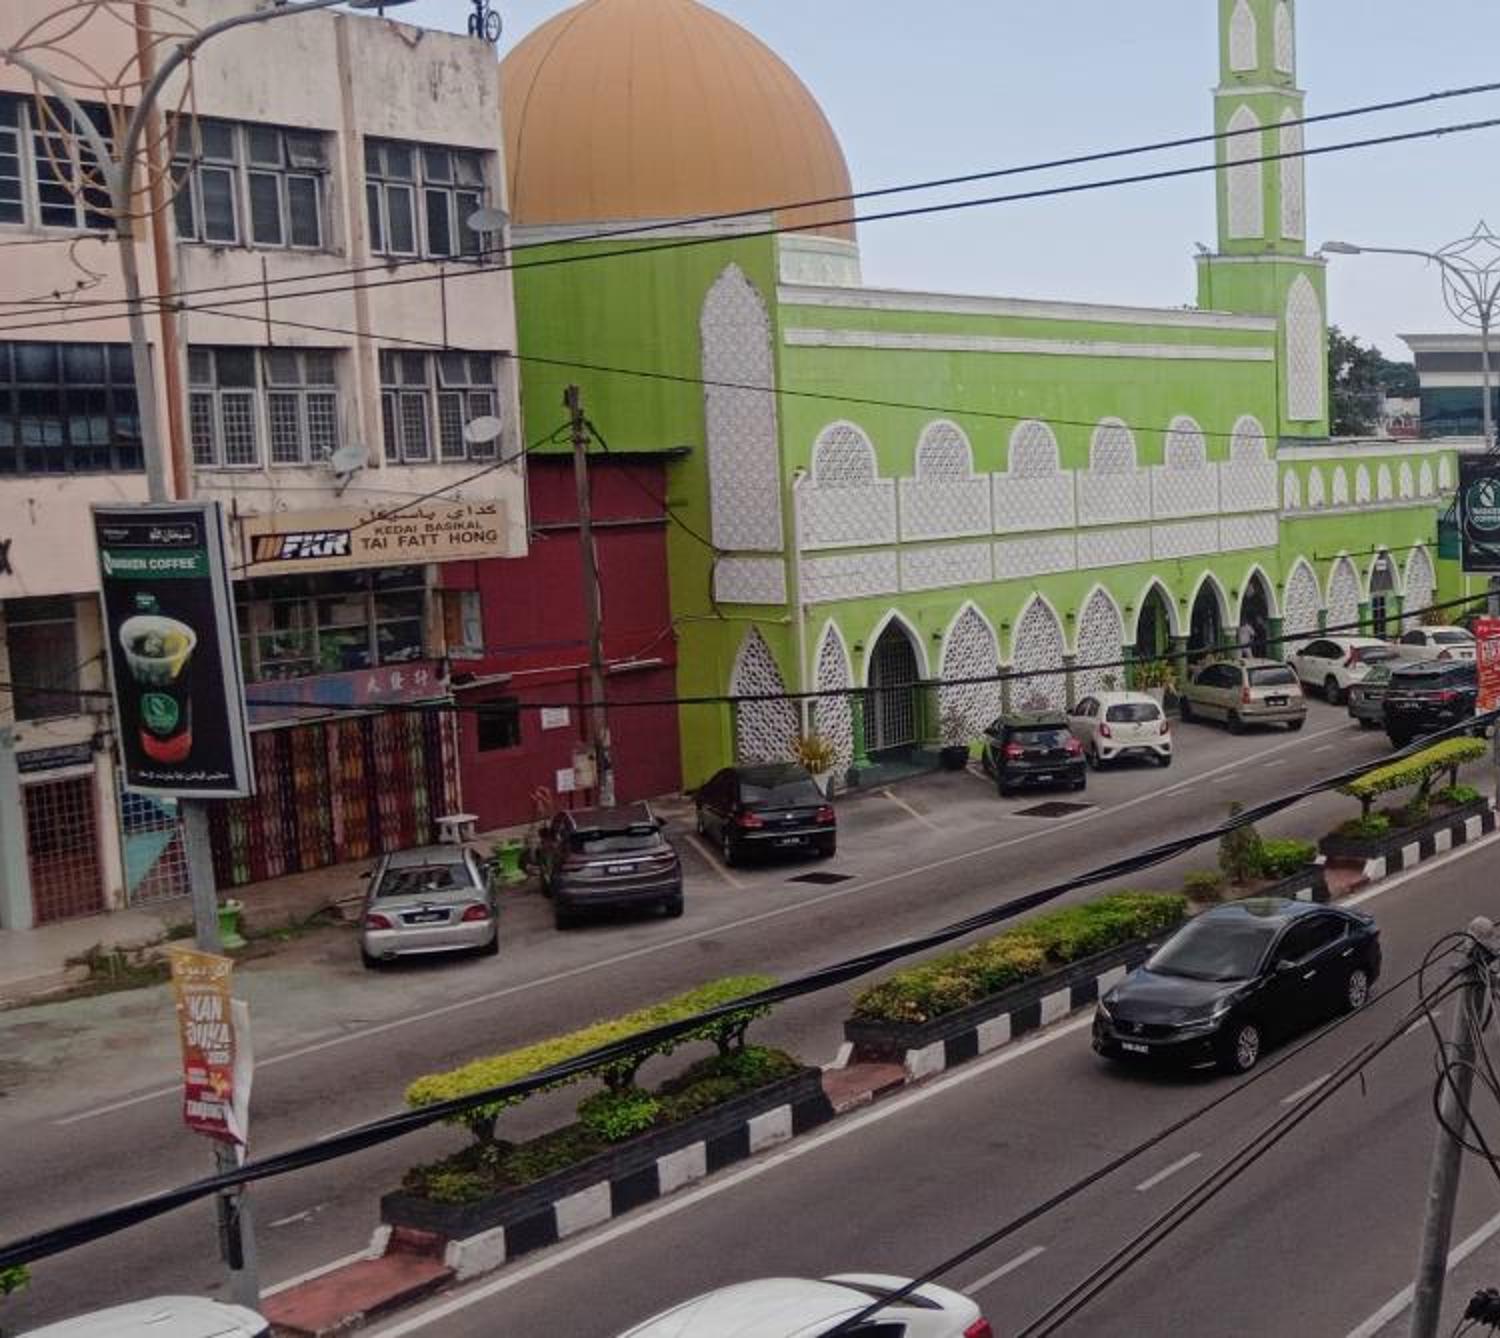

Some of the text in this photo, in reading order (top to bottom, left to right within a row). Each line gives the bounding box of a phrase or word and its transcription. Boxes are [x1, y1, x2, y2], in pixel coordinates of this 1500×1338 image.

[374, 520, 484, 536] KEDAI BASIKAL
[281, 531, 350, 559] FKR
[361, 529, 499, 550] TAI FATT HONG
[149, 558, 197, 569] COFFEE
